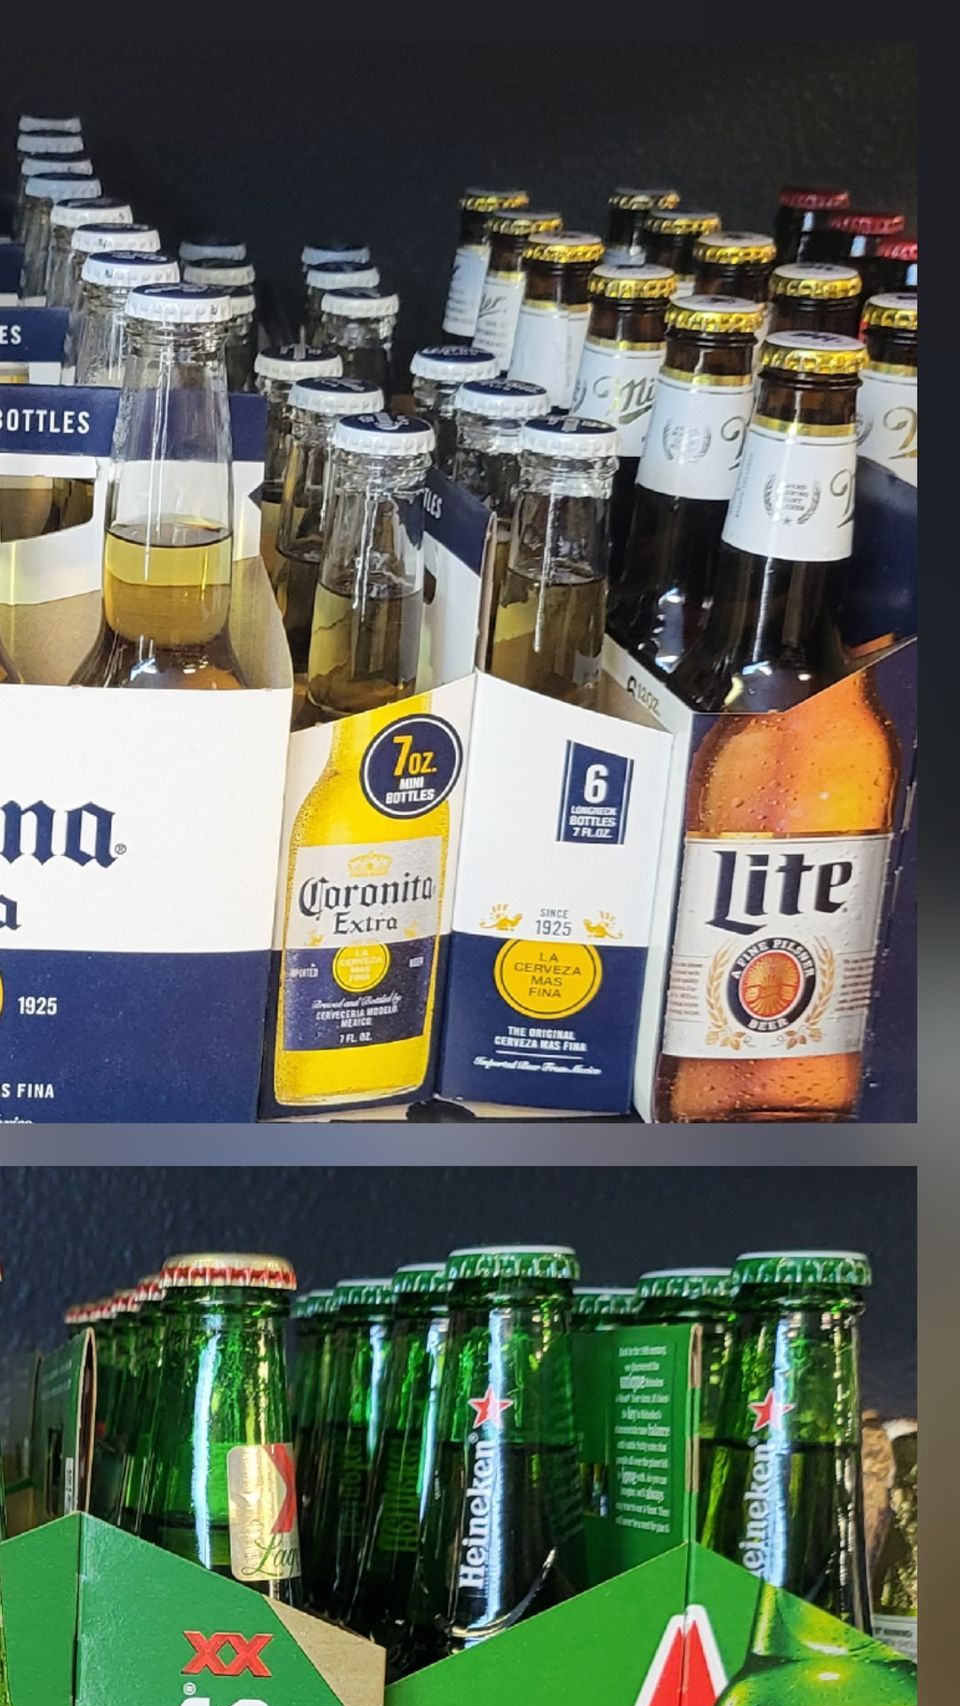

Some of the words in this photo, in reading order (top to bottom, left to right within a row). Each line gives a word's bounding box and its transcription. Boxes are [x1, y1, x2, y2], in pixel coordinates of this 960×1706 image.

[399, 777, 424, 789] MINI
[583, 764, 607, 803] 6
[386, 789, 435, 805] BOTTLES
[569, 815, 617, 828] BOTTLES
[298, 872, 434, 922] Coronita
[705, 850, 853, 935] Lite
[540, 908, 569, 918] SINCE
[332, 912, 398, 936] Extra
[536, 920, 573, 936] 1925
[738, 940, 769, 966] FINE
[773, 937, 817, 978] PILSNER
[18, 996, 58, 1015] 1925
[508, 1026, 527, 1038] THE
[529, 1027, 575, 1040] ORIGINAL
[17, 1083, 54, 1099] FINA
[180, 1630, 273, 1678] XX
